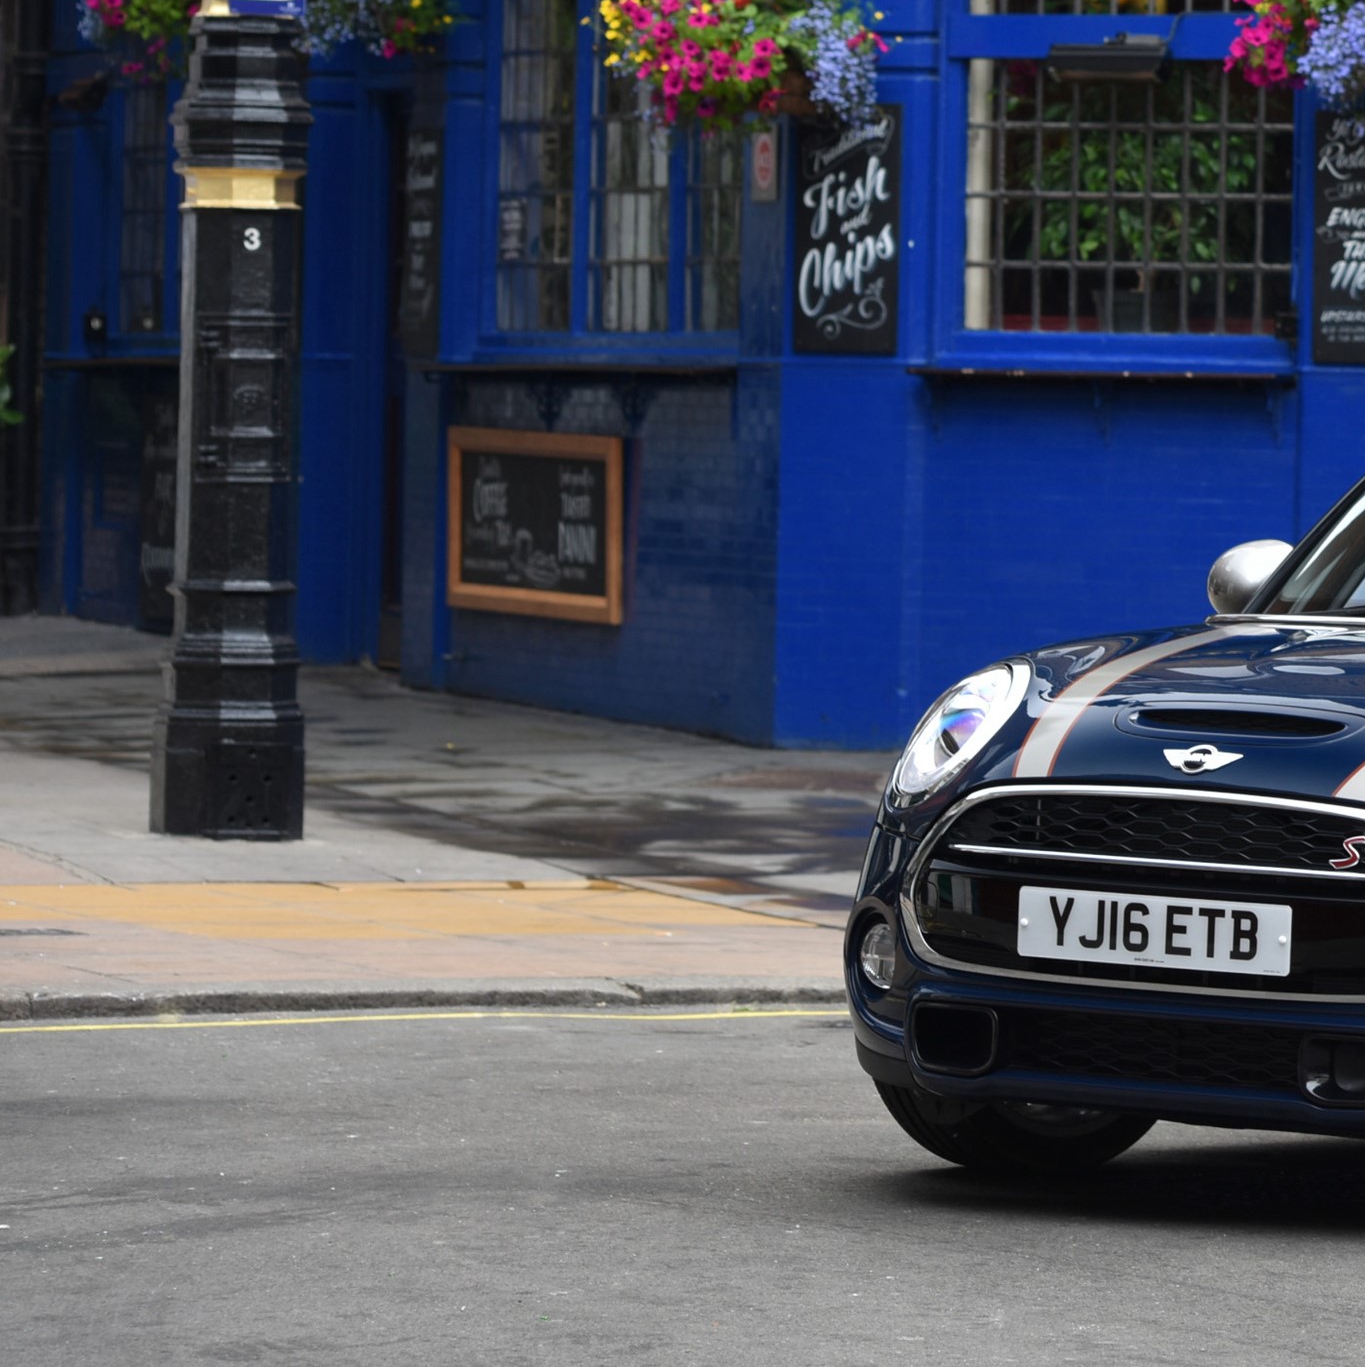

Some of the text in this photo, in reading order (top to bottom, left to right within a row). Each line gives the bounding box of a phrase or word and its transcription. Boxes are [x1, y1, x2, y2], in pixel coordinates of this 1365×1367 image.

[803, 156, 890, 240] Fish
[839, 203, 873, 235] and
[243, 227, 262, 251] 3
[798, 223, 895, 317] Chips
[1049, 896, 1259, 961] YJ16 ETB
